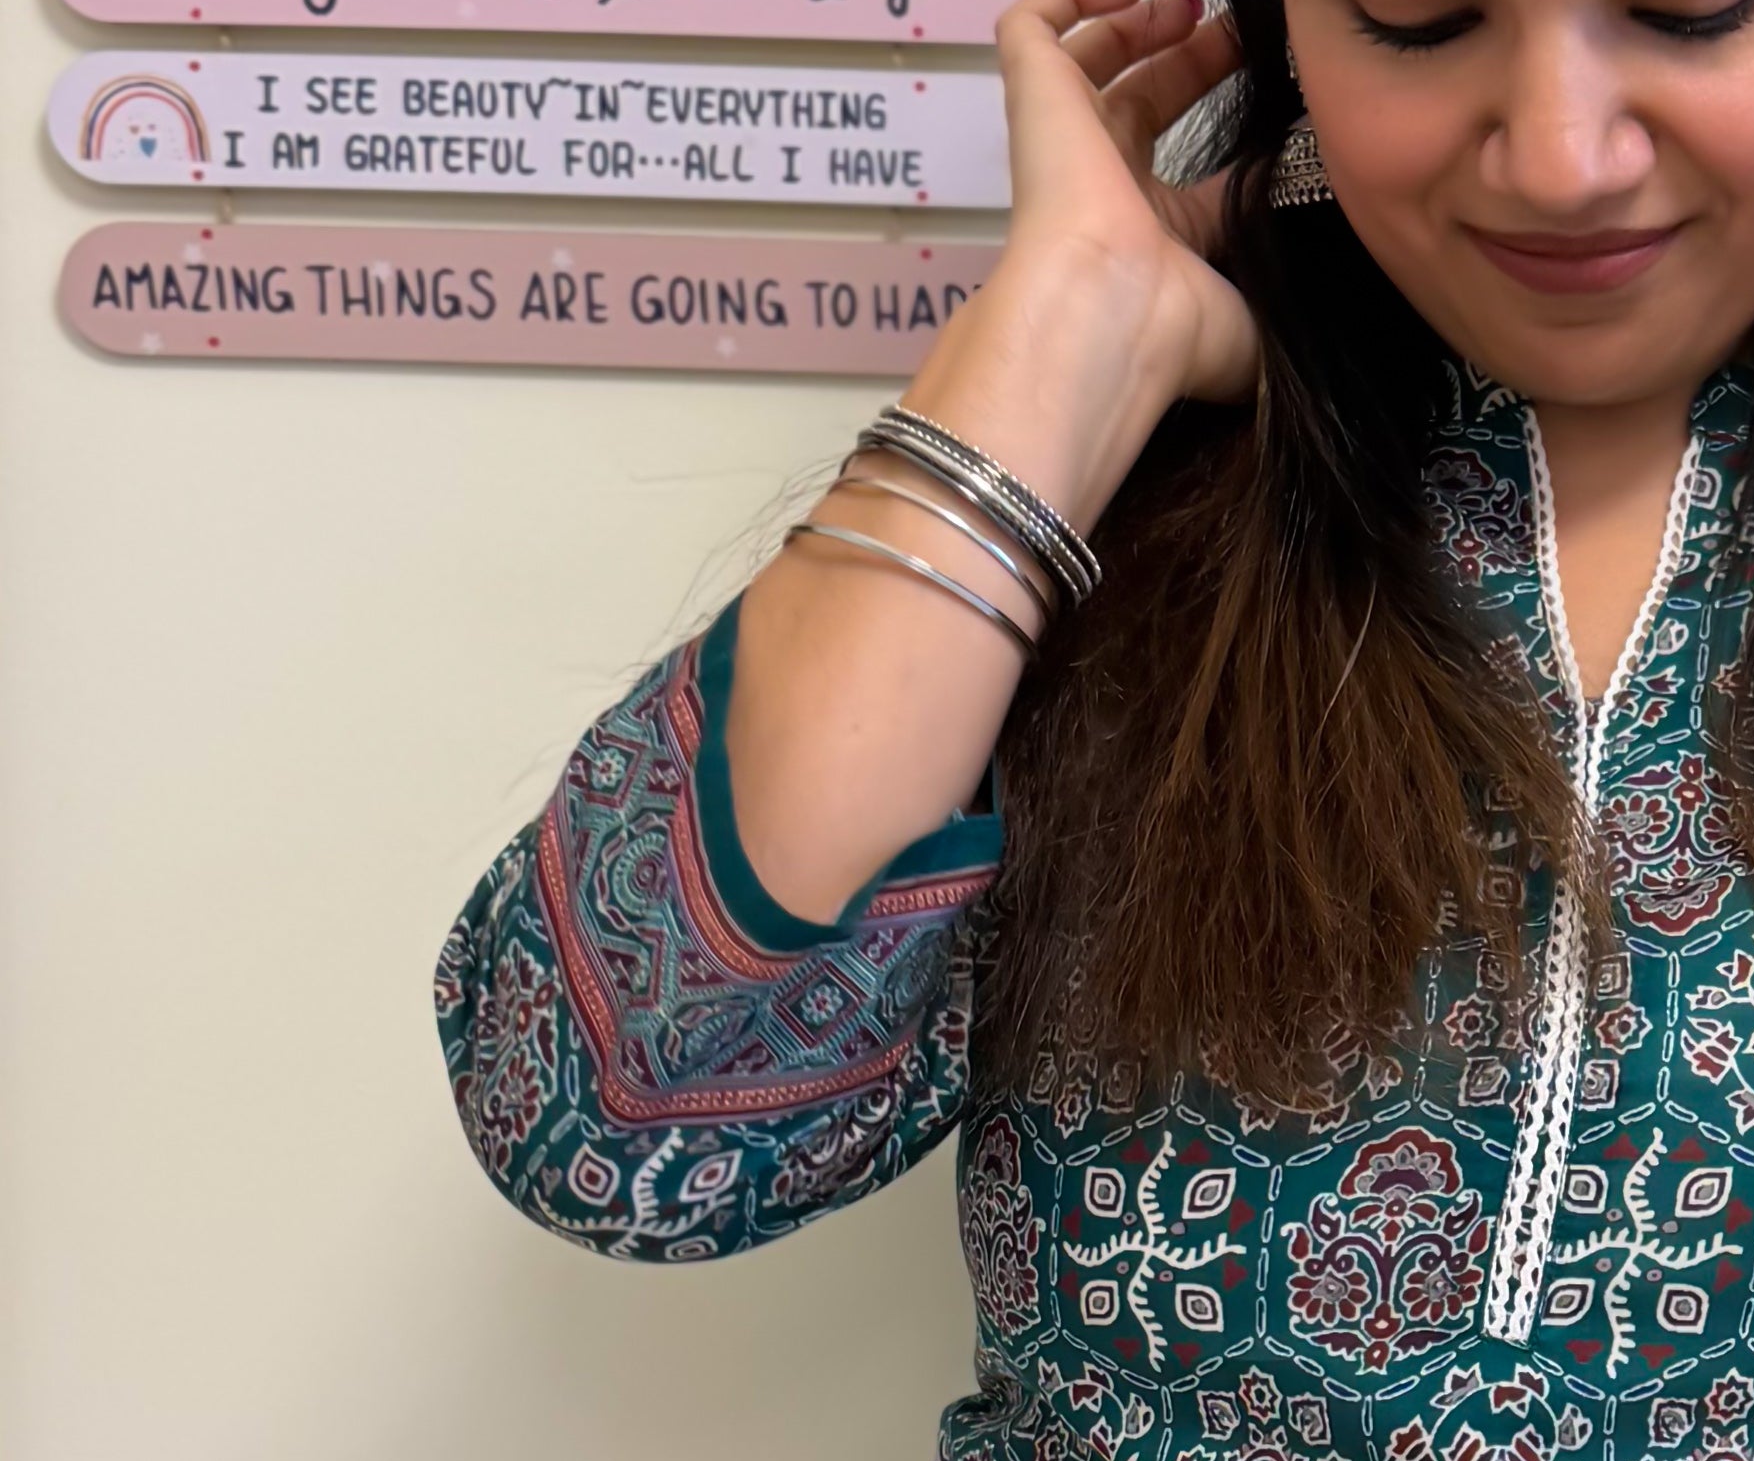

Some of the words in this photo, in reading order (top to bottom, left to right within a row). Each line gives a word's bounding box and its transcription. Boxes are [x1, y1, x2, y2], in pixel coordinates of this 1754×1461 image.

[257, 75, 279, 114] I
[305, 76, 377, 116] SEE
[223, 130, 246, 169] I
[272, 132, 320, 169] AM
[343, 133, 537, 176] GRATEFUL
[780, 145, 801, 185] I
[828, 148, 923, 188] HAVE
[92, 263, 295, 314] AMAZING
[519, 271, 608, 325] ARE
[630, 274, 789, 327] GOING
[804, 281, 859, 329] TO
